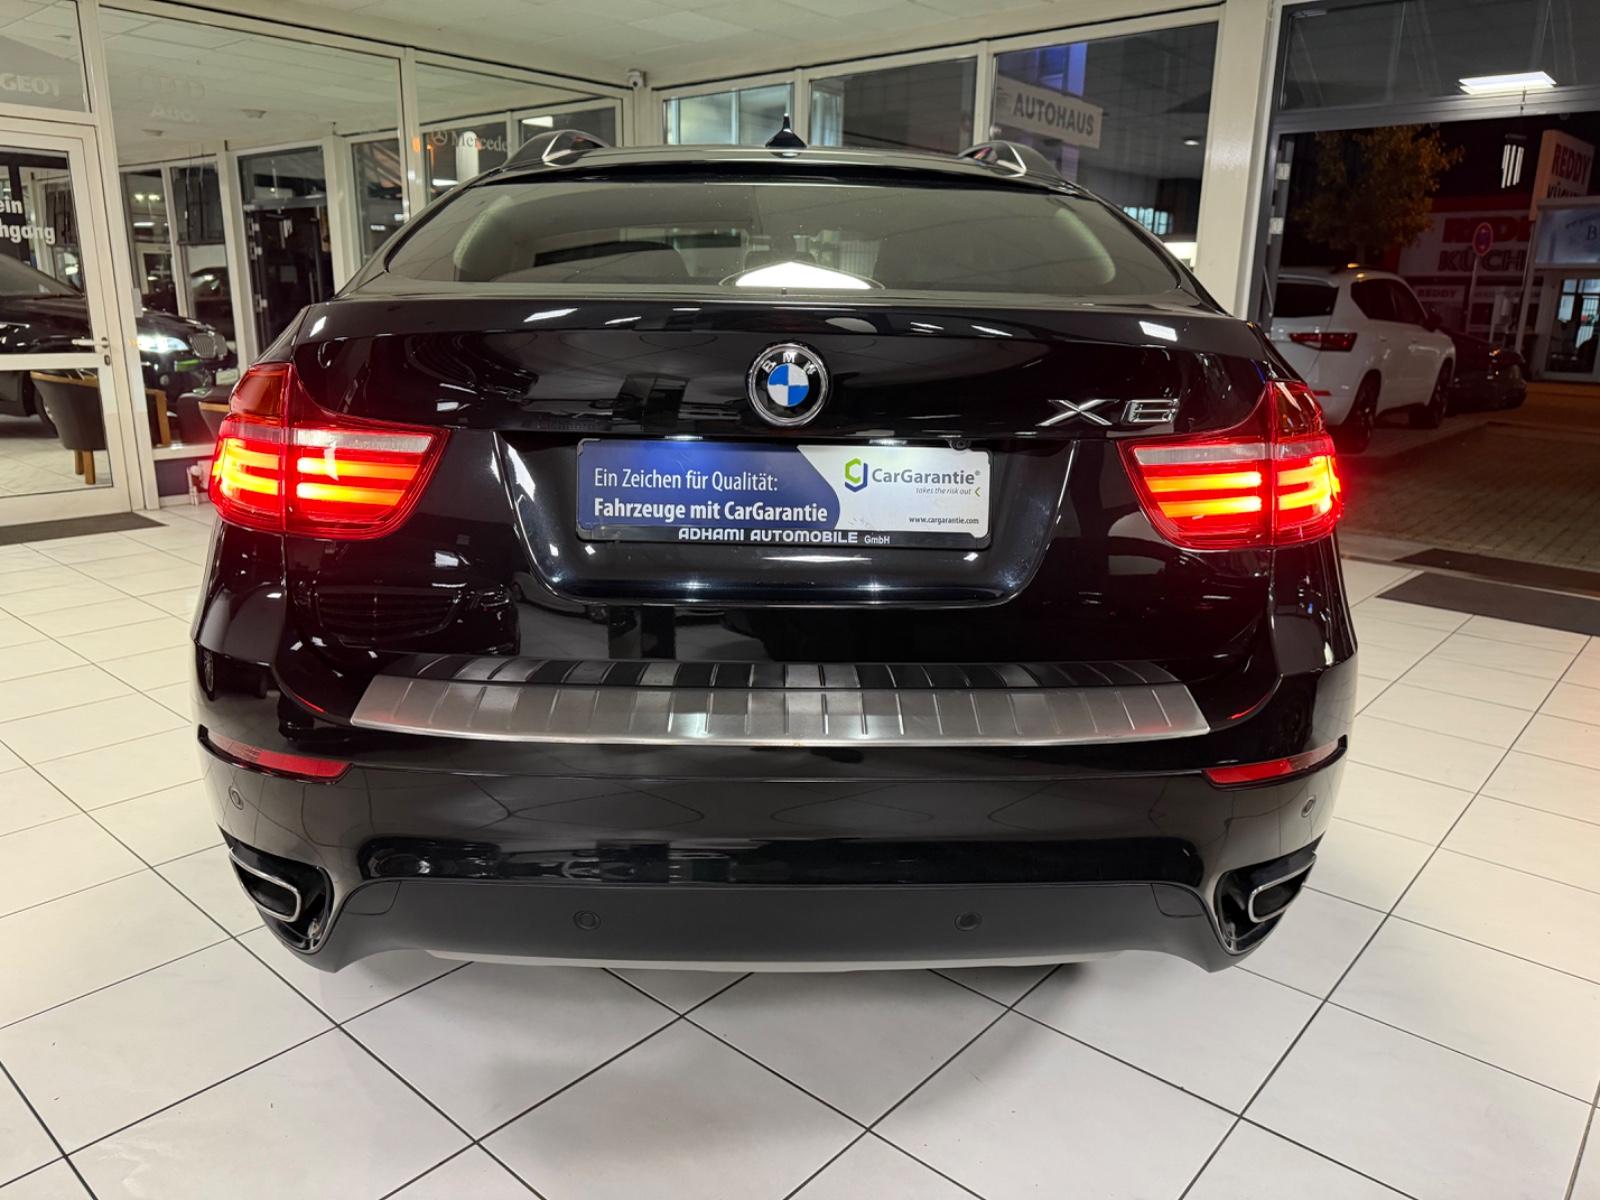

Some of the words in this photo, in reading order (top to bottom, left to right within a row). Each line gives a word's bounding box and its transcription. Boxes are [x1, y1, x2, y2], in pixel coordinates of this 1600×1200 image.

[1013, 92, 1095, 137] AUTOHAUS
[1551, 143, 1592, 186] REDDY
[761, 351, 817, 375] BMW
[594, 467, 618, 487] Ein
[622, 468, 681, 489] Zeichen
[686, 470, 709, 490] für
[712, 471, 778, 492] Qualität:
[935, 487, 945, 495] the
[946, 487, 959, 496] risk
[594, 498, 686, 523] Fahrzeuge
[690, 501, 720, 520] mit
[724, 501, 828, 522] CarGarantie
[908, 515, 980, 526] www.cargarantie.com
[678, 527, 745, 541] ADHAMI
[750, 529, 858, 544] AUTOMOBILE
[864, 534, 890, 545] GmbH
